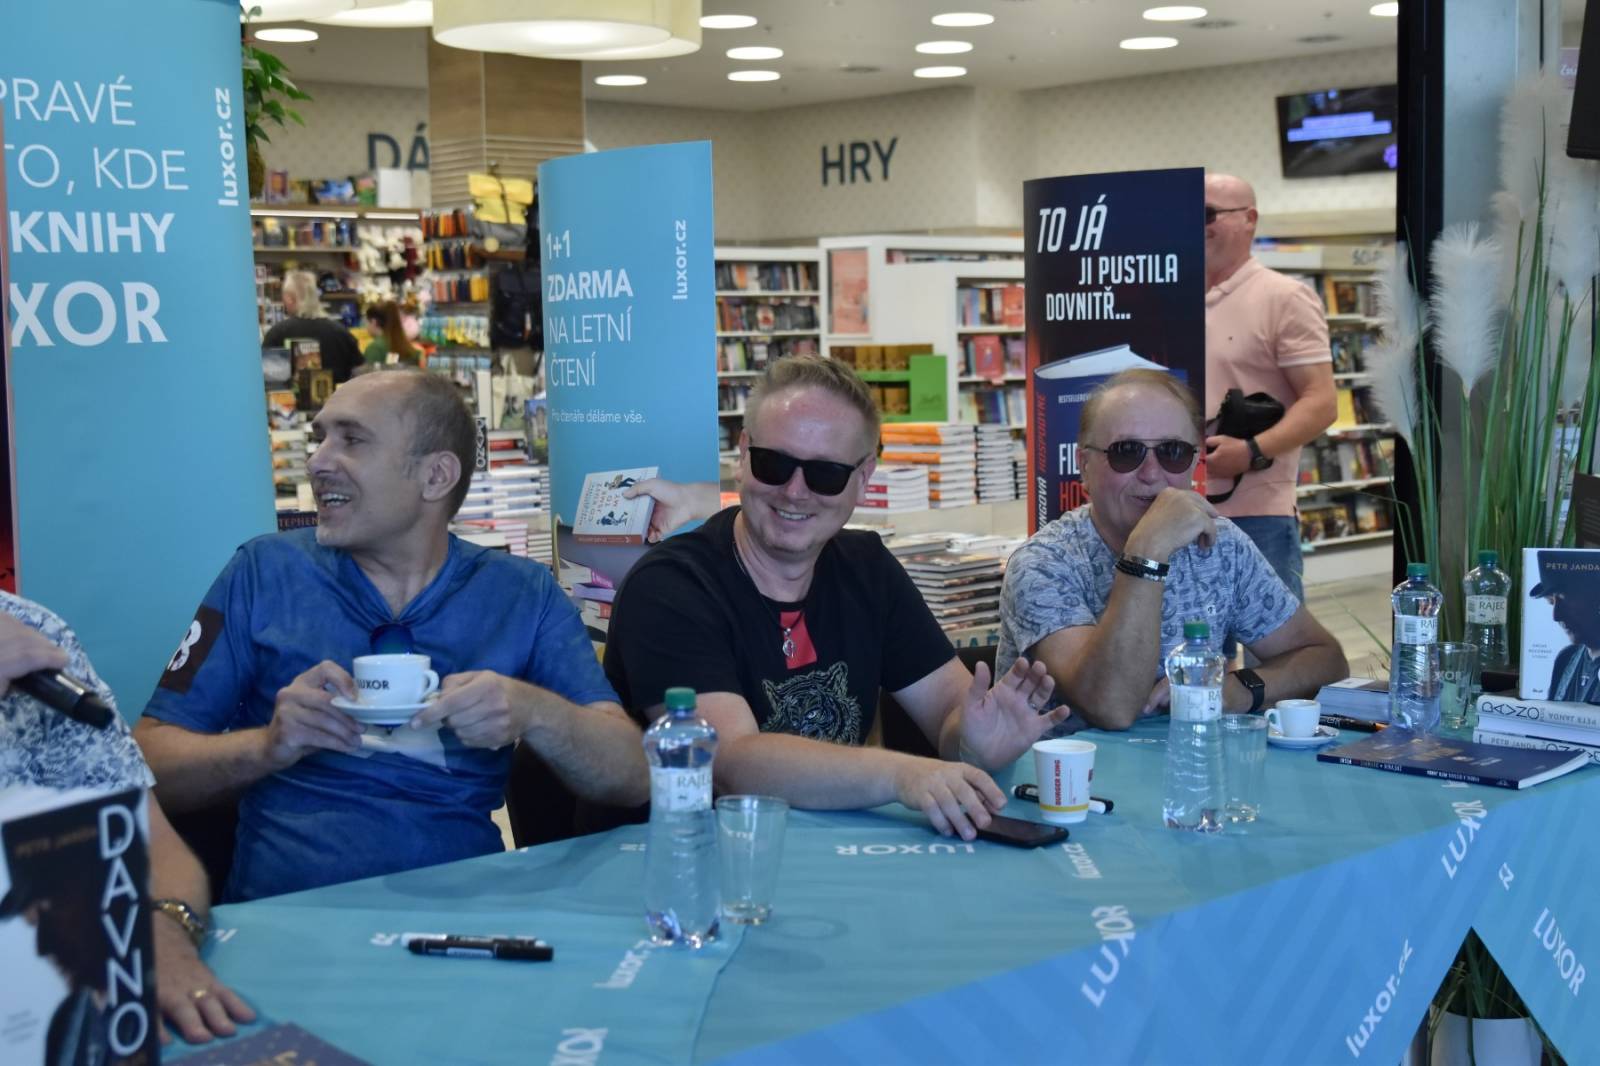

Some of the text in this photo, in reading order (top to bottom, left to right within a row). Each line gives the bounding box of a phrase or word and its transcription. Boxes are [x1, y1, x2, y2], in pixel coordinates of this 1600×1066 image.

[215, 87, 239, 206] luxor.cz
[820, 138, 898, 186] HRY
[93, 147, 189, 191] KDE
[9, 211, 175, 253] KNIHY
[546, 230, 571, 260] 1+1
[1037, 194, 1108, 253] TO JÁ
[673, 220, 688, 300] luxor.cz
[1078, 254, 1178, 285] JI PUSTILA
[547, 268, 633, 302] ZDARMA
[1046, 286, 1131, 321] DOVNITŘ...
[549, 306, 632, 344] NA LETNÍ
[550, 351, 596, 386] ČTENÍ
[586, 409, 621, 423] děláme
[624, 411, 646, 423] vše.
[1546, 562, 1600, 571] PETR JANDA
[835, 843, 975, 855] LUXOR
[1442, 800, 1488, 879] LUXOR
[99, 804, 148, 1056] DAVNO
[1532, 906, 1586, 997] LUXOR
[1080, 905, 1136, 1008] LUXOR
[1345, 938, 1413, 1059] luxor.cz
